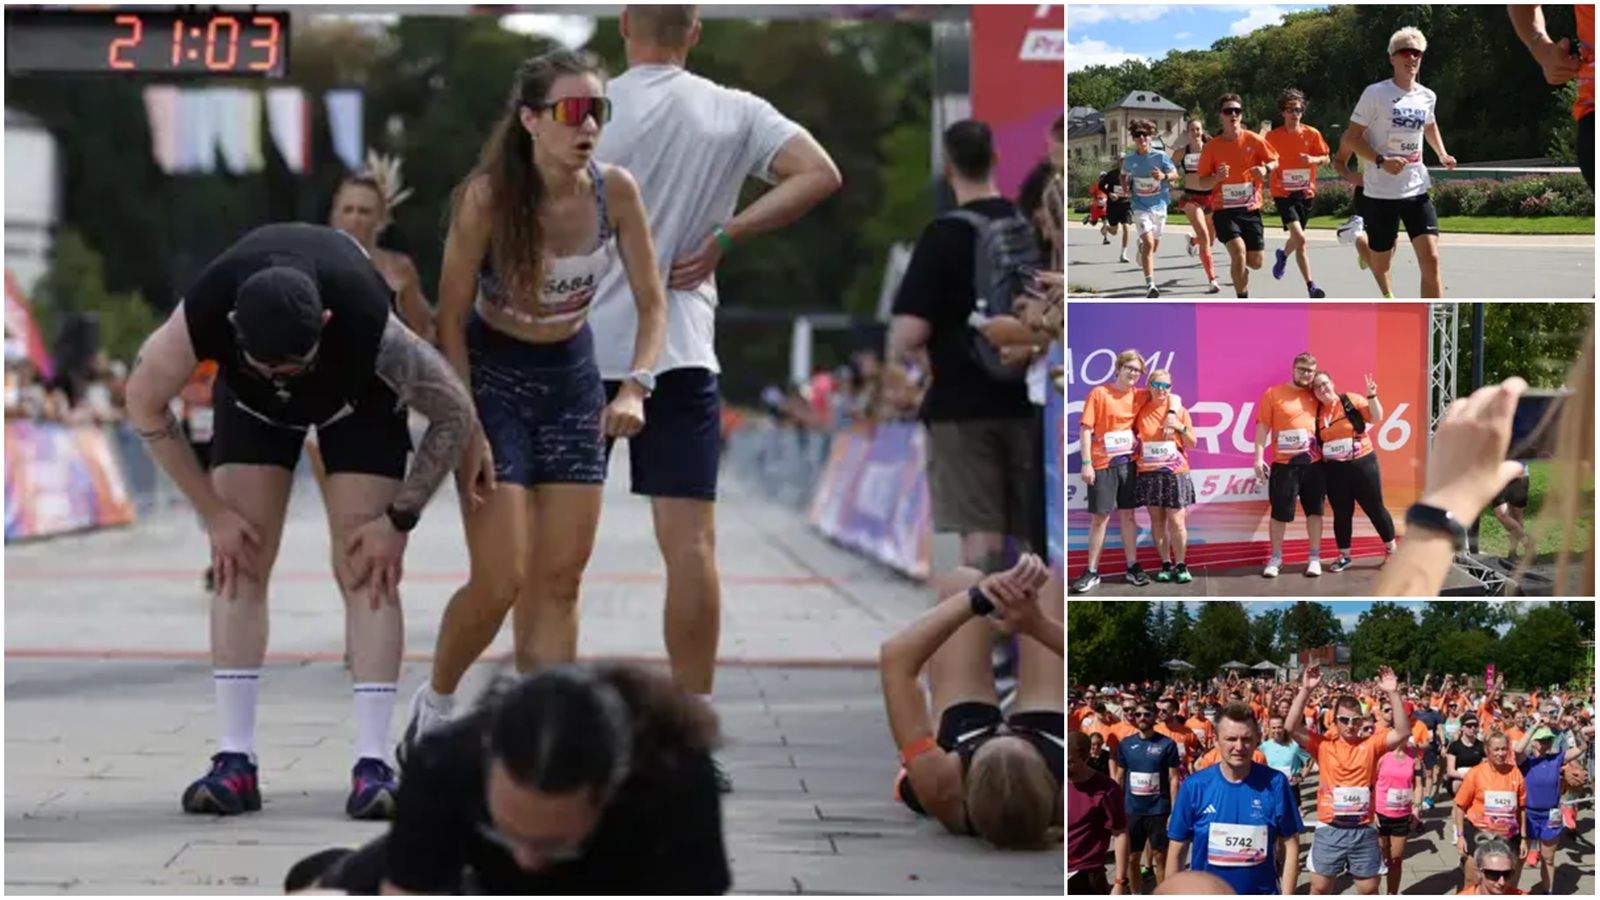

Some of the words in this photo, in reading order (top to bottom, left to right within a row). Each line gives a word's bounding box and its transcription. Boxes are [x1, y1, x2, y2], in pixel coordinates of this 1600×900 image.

[109, 15, 280, 69] 21:03
[543, 274, 594, 294] 5684
[1200, 475, 1220, 496] 5
[1225, 836, 1253, 848] 5742
